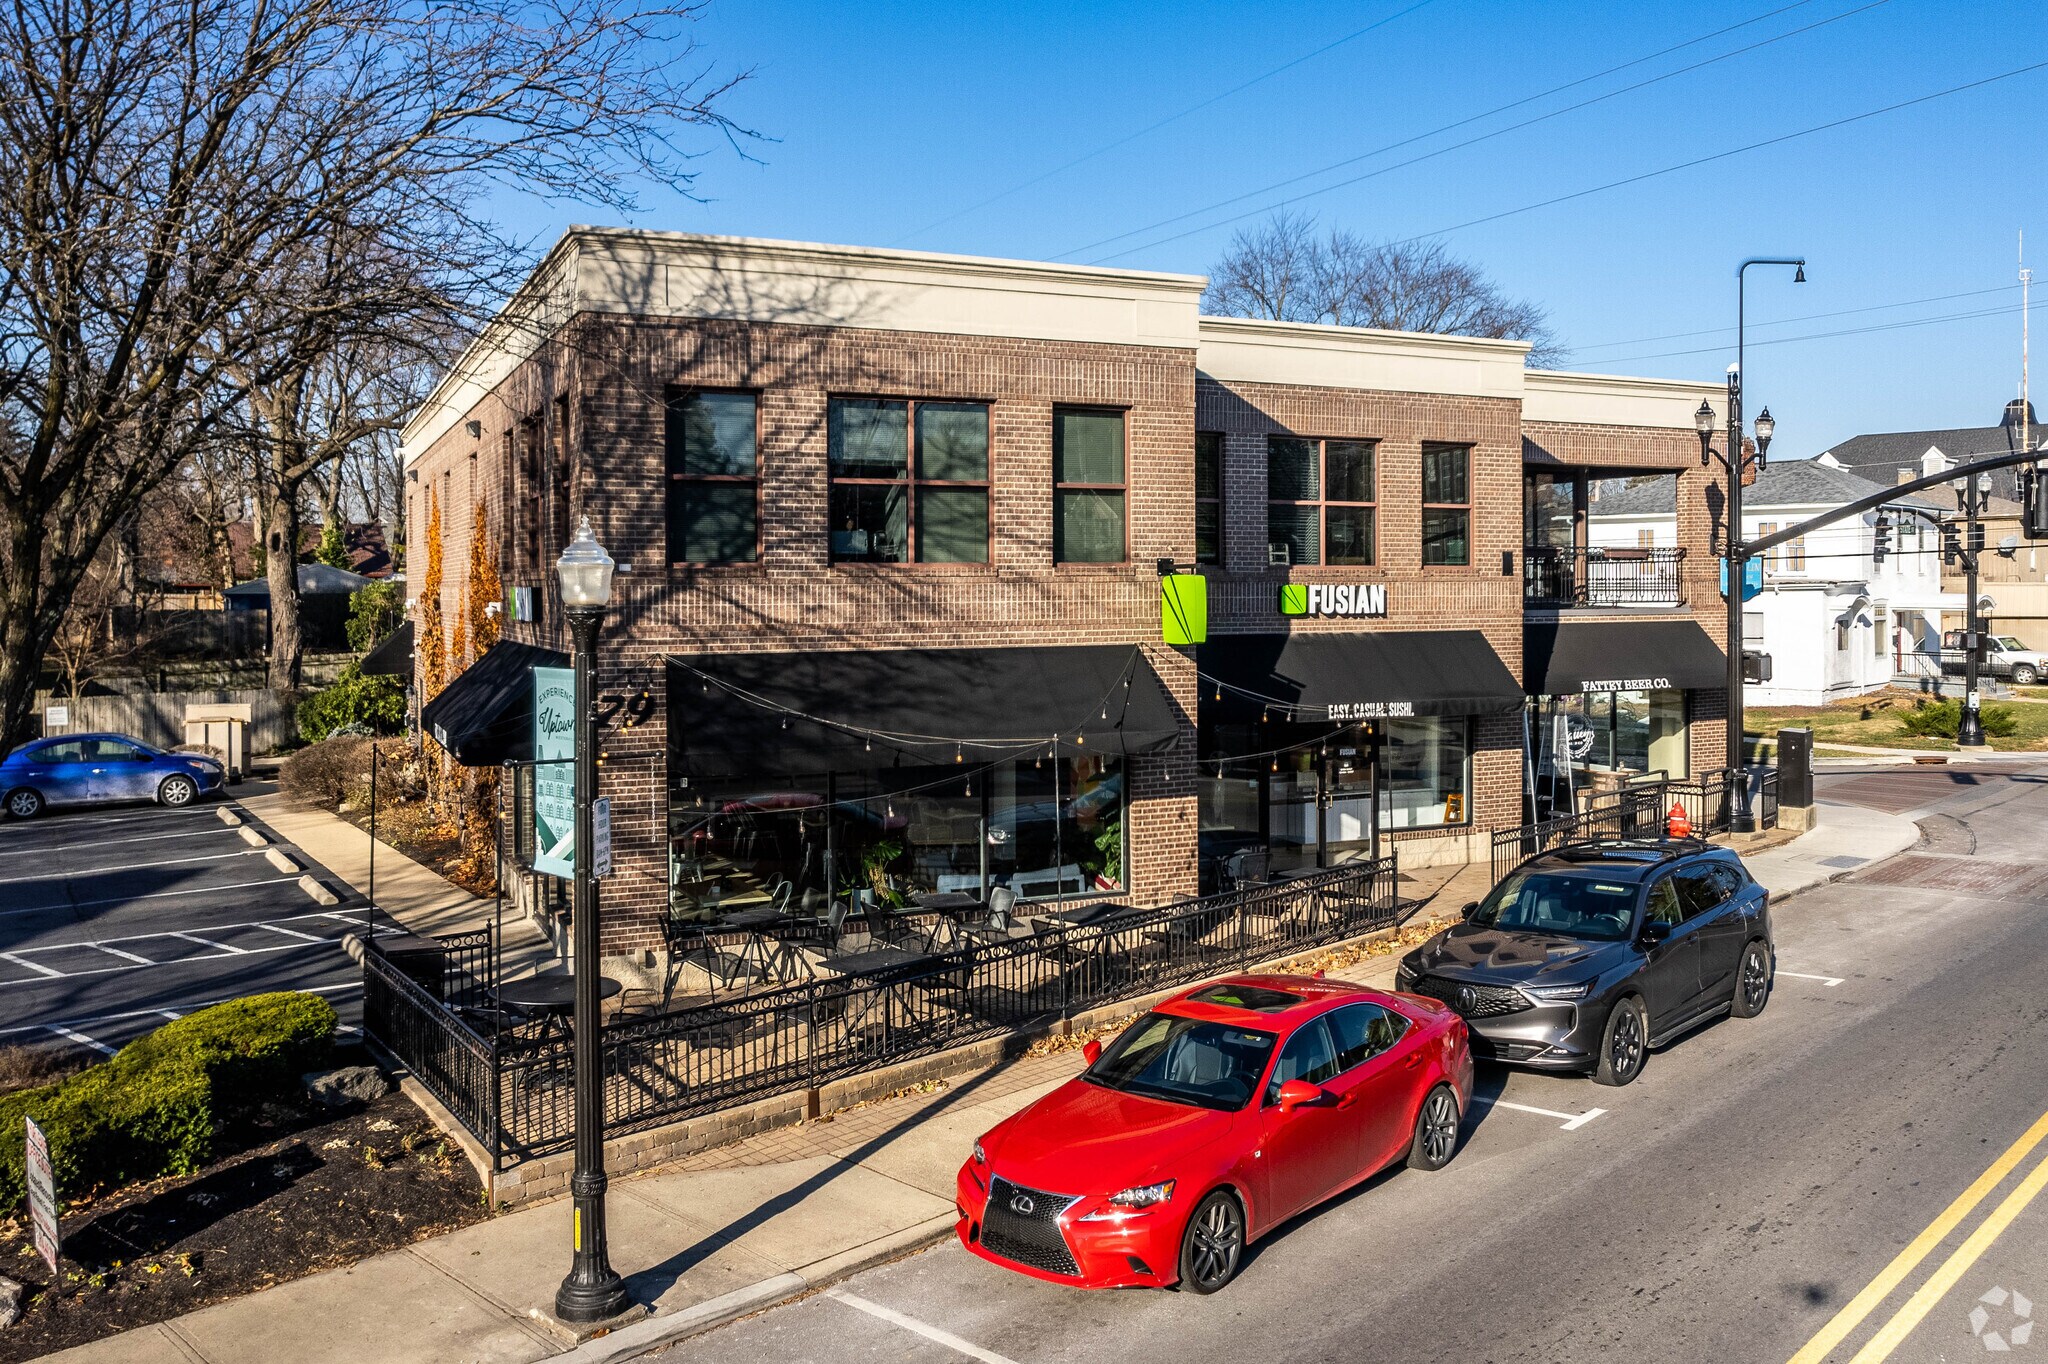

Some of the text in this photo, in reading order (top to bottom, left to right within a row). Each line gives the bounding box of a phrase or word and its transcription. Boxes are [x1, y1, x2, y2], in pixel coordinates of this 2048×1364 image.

[1308, 584, 1385, 614] FUSIAN
[1581, 677, 1672, 692] FATTEY BEER CO.
[539, 687, 575, 704] EXPERIENC
[1328, 704, 1354, 720] EASY.
[1388, 701, 1415, 717] SUSHI.
[539, 707, 575, 740] Uptown
